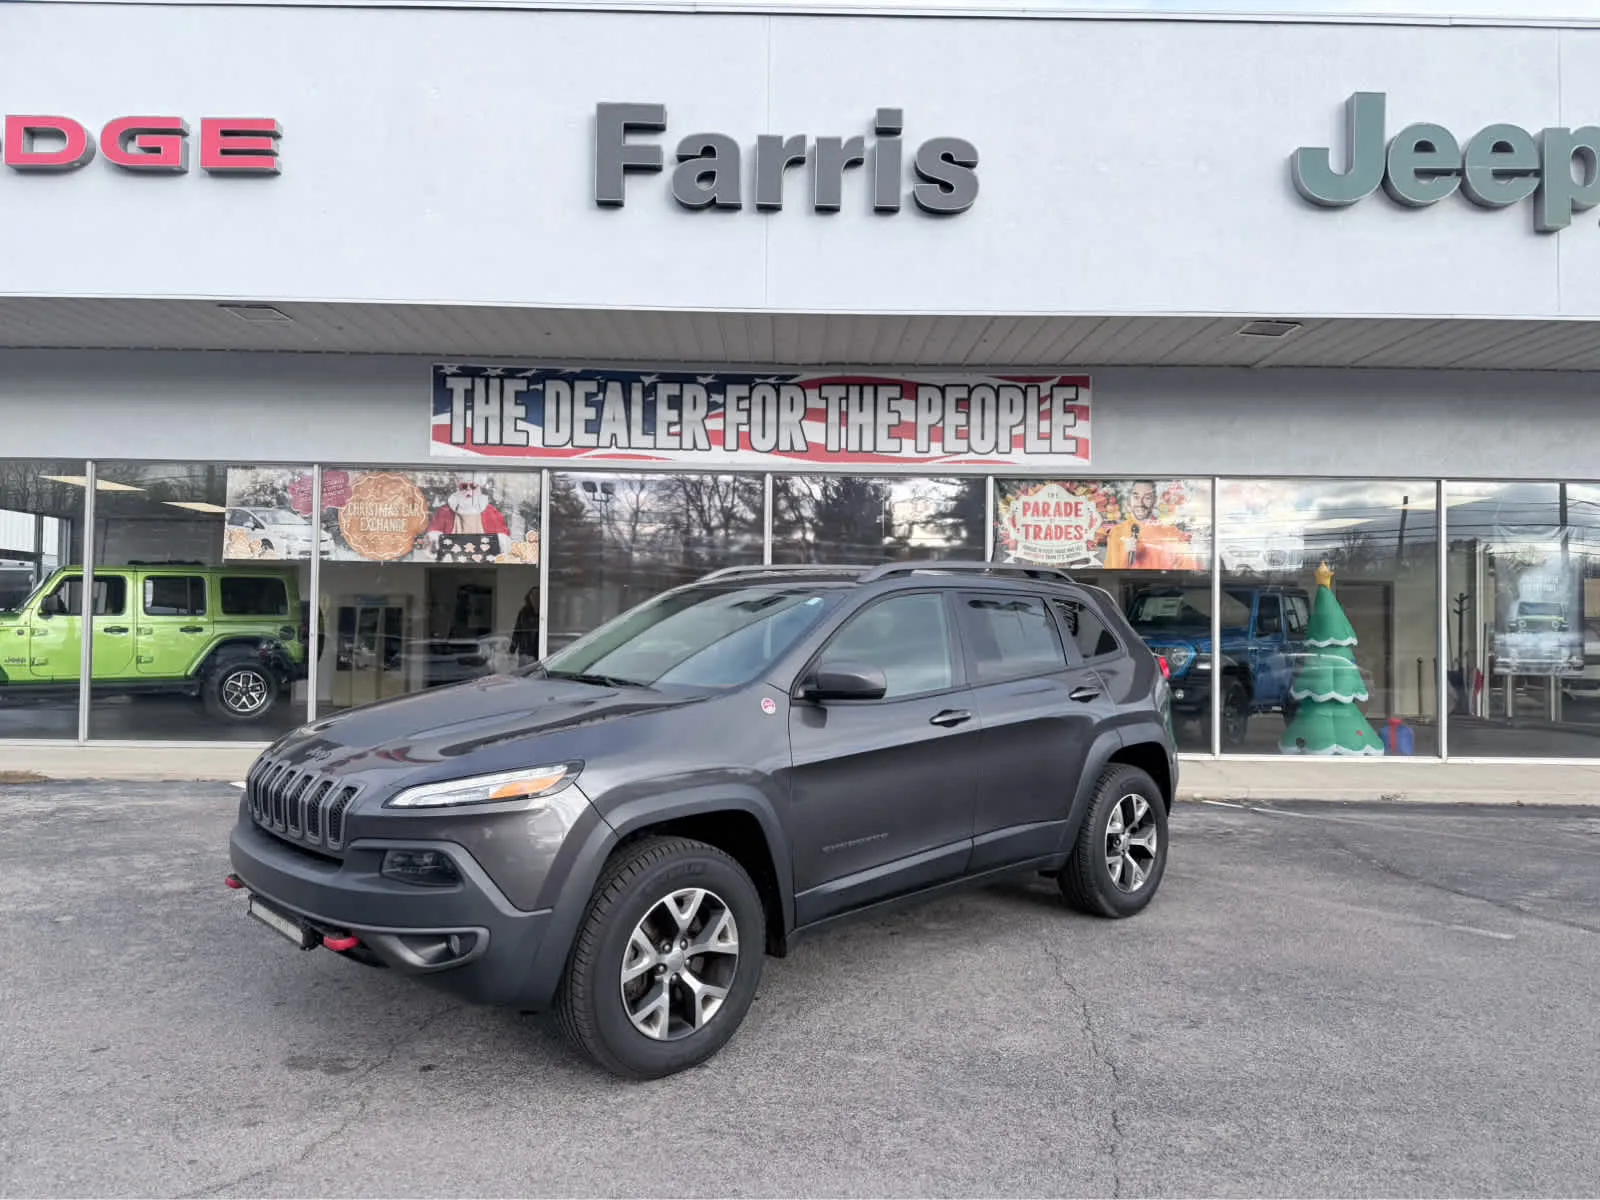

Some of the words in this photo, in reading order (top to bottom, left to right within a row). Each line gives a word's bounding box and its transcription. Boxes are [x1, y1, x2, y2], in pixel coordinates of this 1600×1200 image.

[0, 114, 282, 175] DGE
[594, 102, 979, 214] Farris
[1291, 91, 1600, 234] Jeep
[445, 375, 531, 447] THE
[542, 380, 711, 452] DEALER
[723, 383, 807, 453] FOR
[820, 383, 902, 454] THE
[914, 384, 1078, 454] PEOPLE
[1021, 524, 1084, 541] TRADES
[1022, 501, 1084, 518] PARADE
